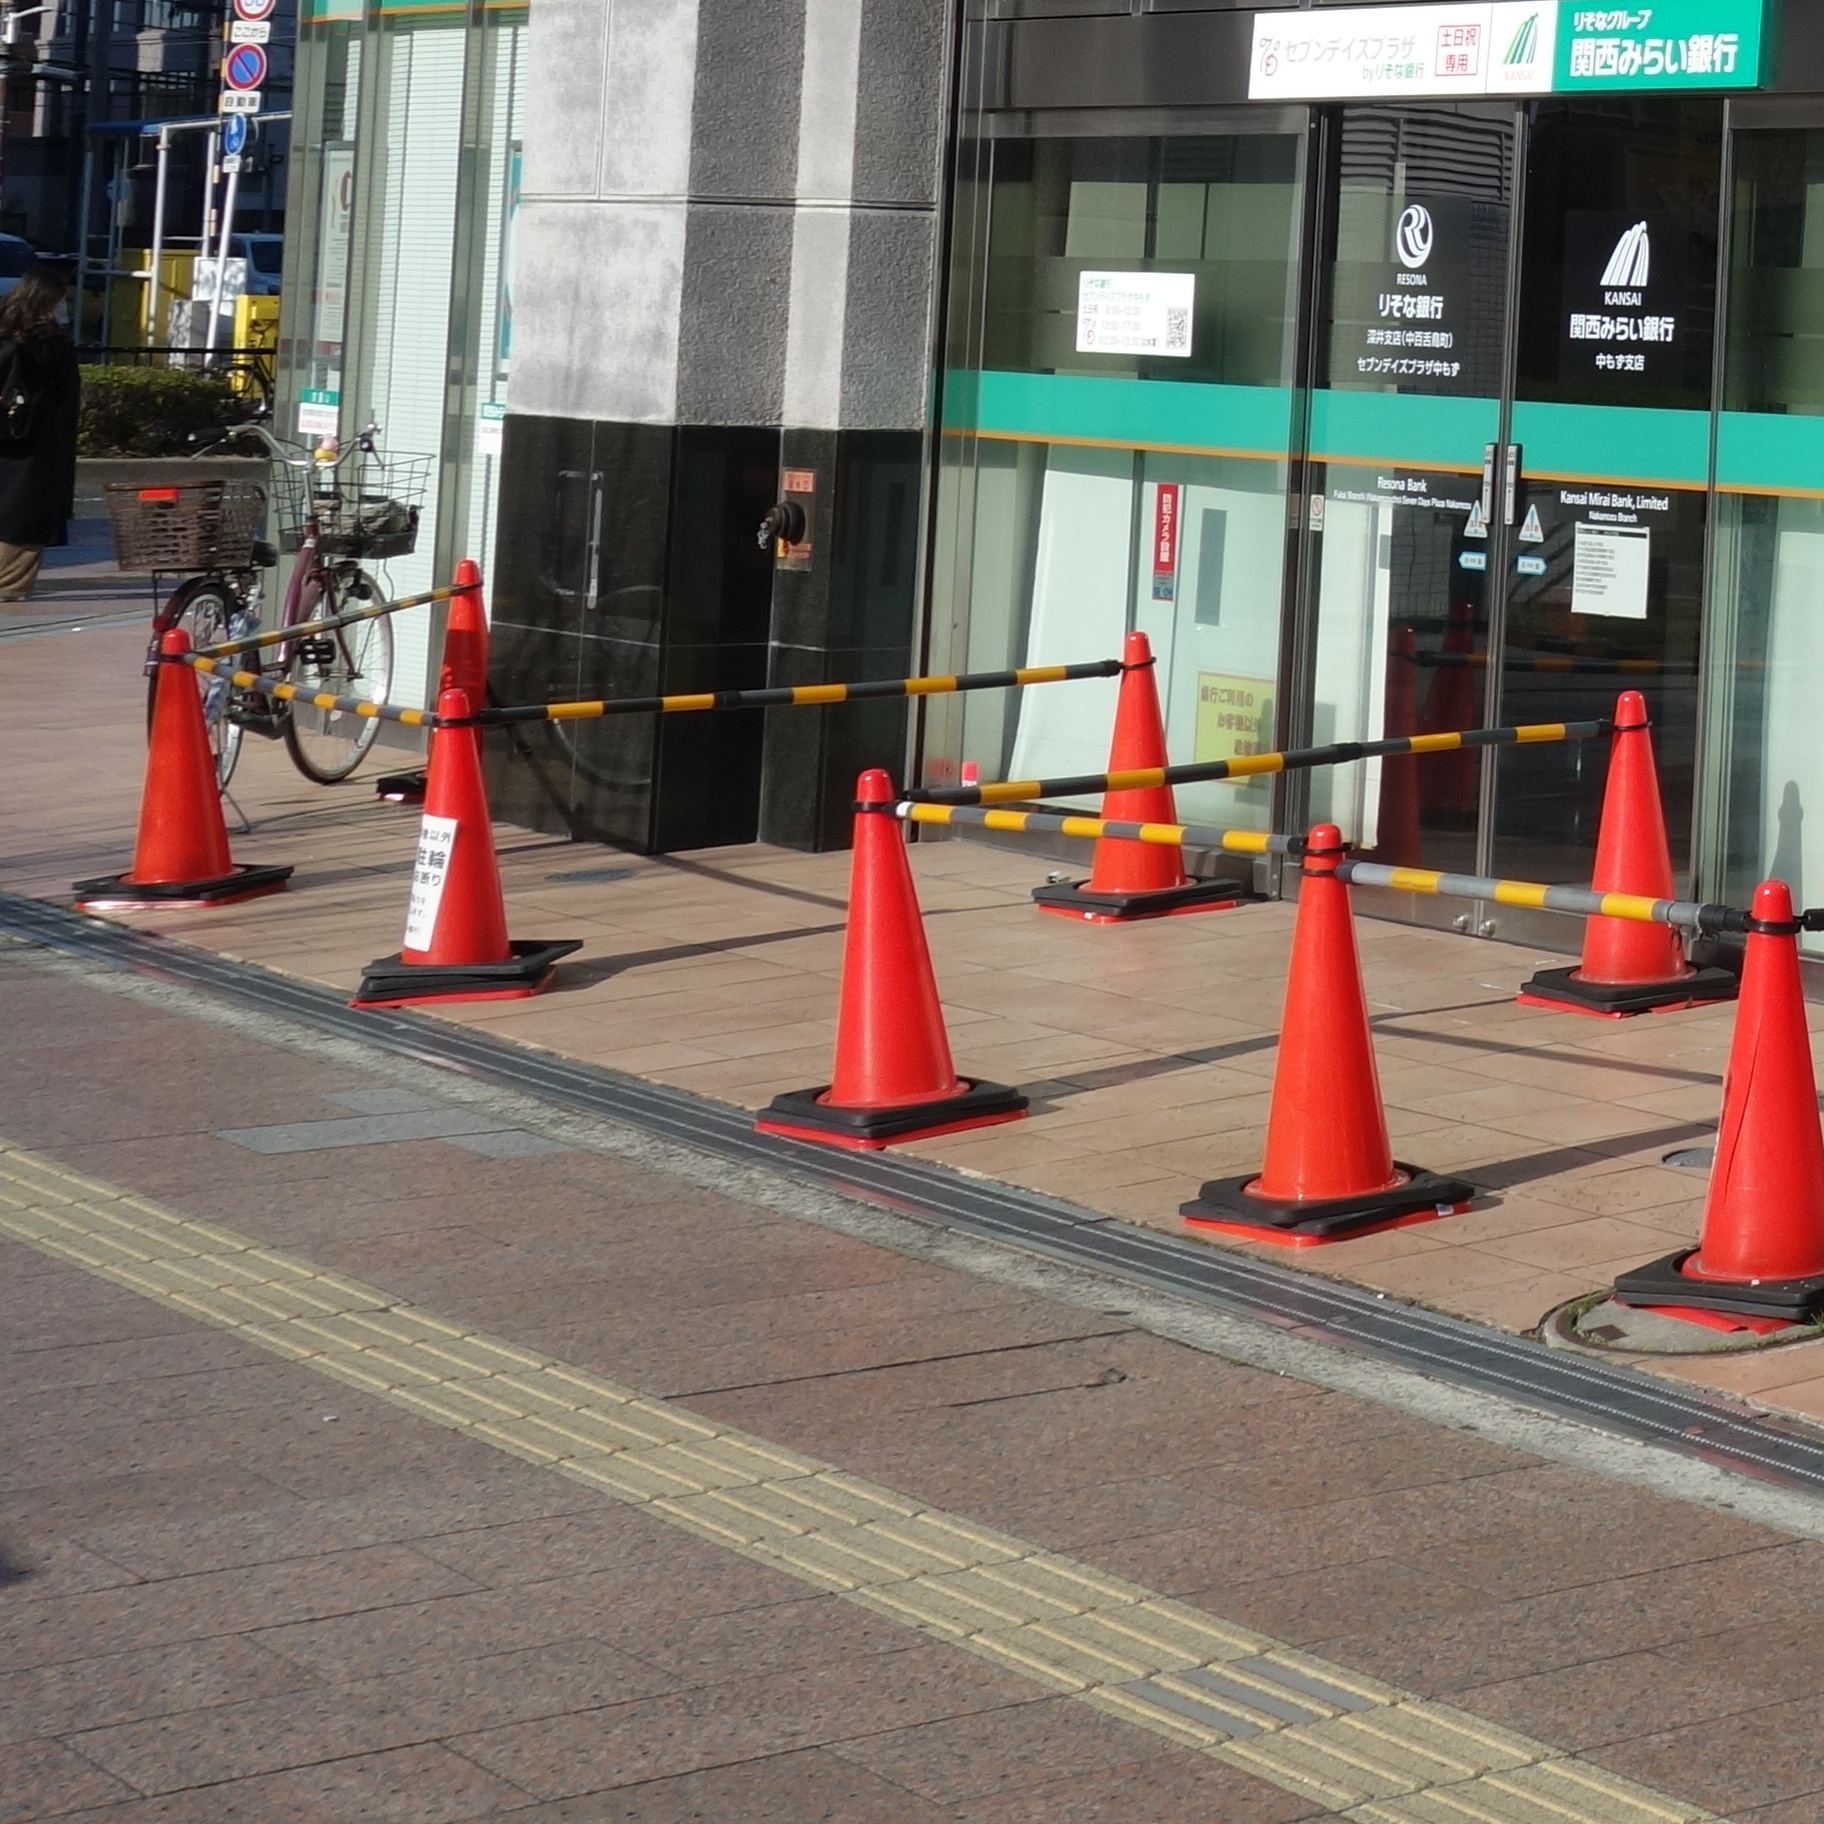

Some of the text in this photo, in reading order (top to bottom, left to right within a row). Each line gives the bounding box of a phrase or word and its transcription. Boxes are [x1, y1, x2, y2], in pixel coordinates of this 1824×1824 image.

[1573, 9, 1653, 32] りそなグループ
[1441, 28, 1478, 48] 土日祝
[1284, 36, 1416, 64] セブンデイズプラザ
[1569, 33, 1740, 77] 関西みらい銀行
[1362, 62, 1425, 82] byりそな銀行
[1445, 53, 1468, 73] 専用
[1504, 70, 1534, 81] KANSAI
[1396, 273, 1427, 286] RESONA
[1379, 294, 1443, 319] りそな銀行
[1604, 291, 1642, 306] KANSAI
[1570, 314, 1675, 342] 関西みらい銀行
[1357, 357, 1460, 377] セブンデイズプラザ中もず
[1596, 352, 1645, 371] 中もず支店
[1377, 476, 1427, 493] Resona Bank
[1560, 490, 1669, 511] Kansai Mirai Bank, Limited
[1617, 512, 1638, 523] Branch
